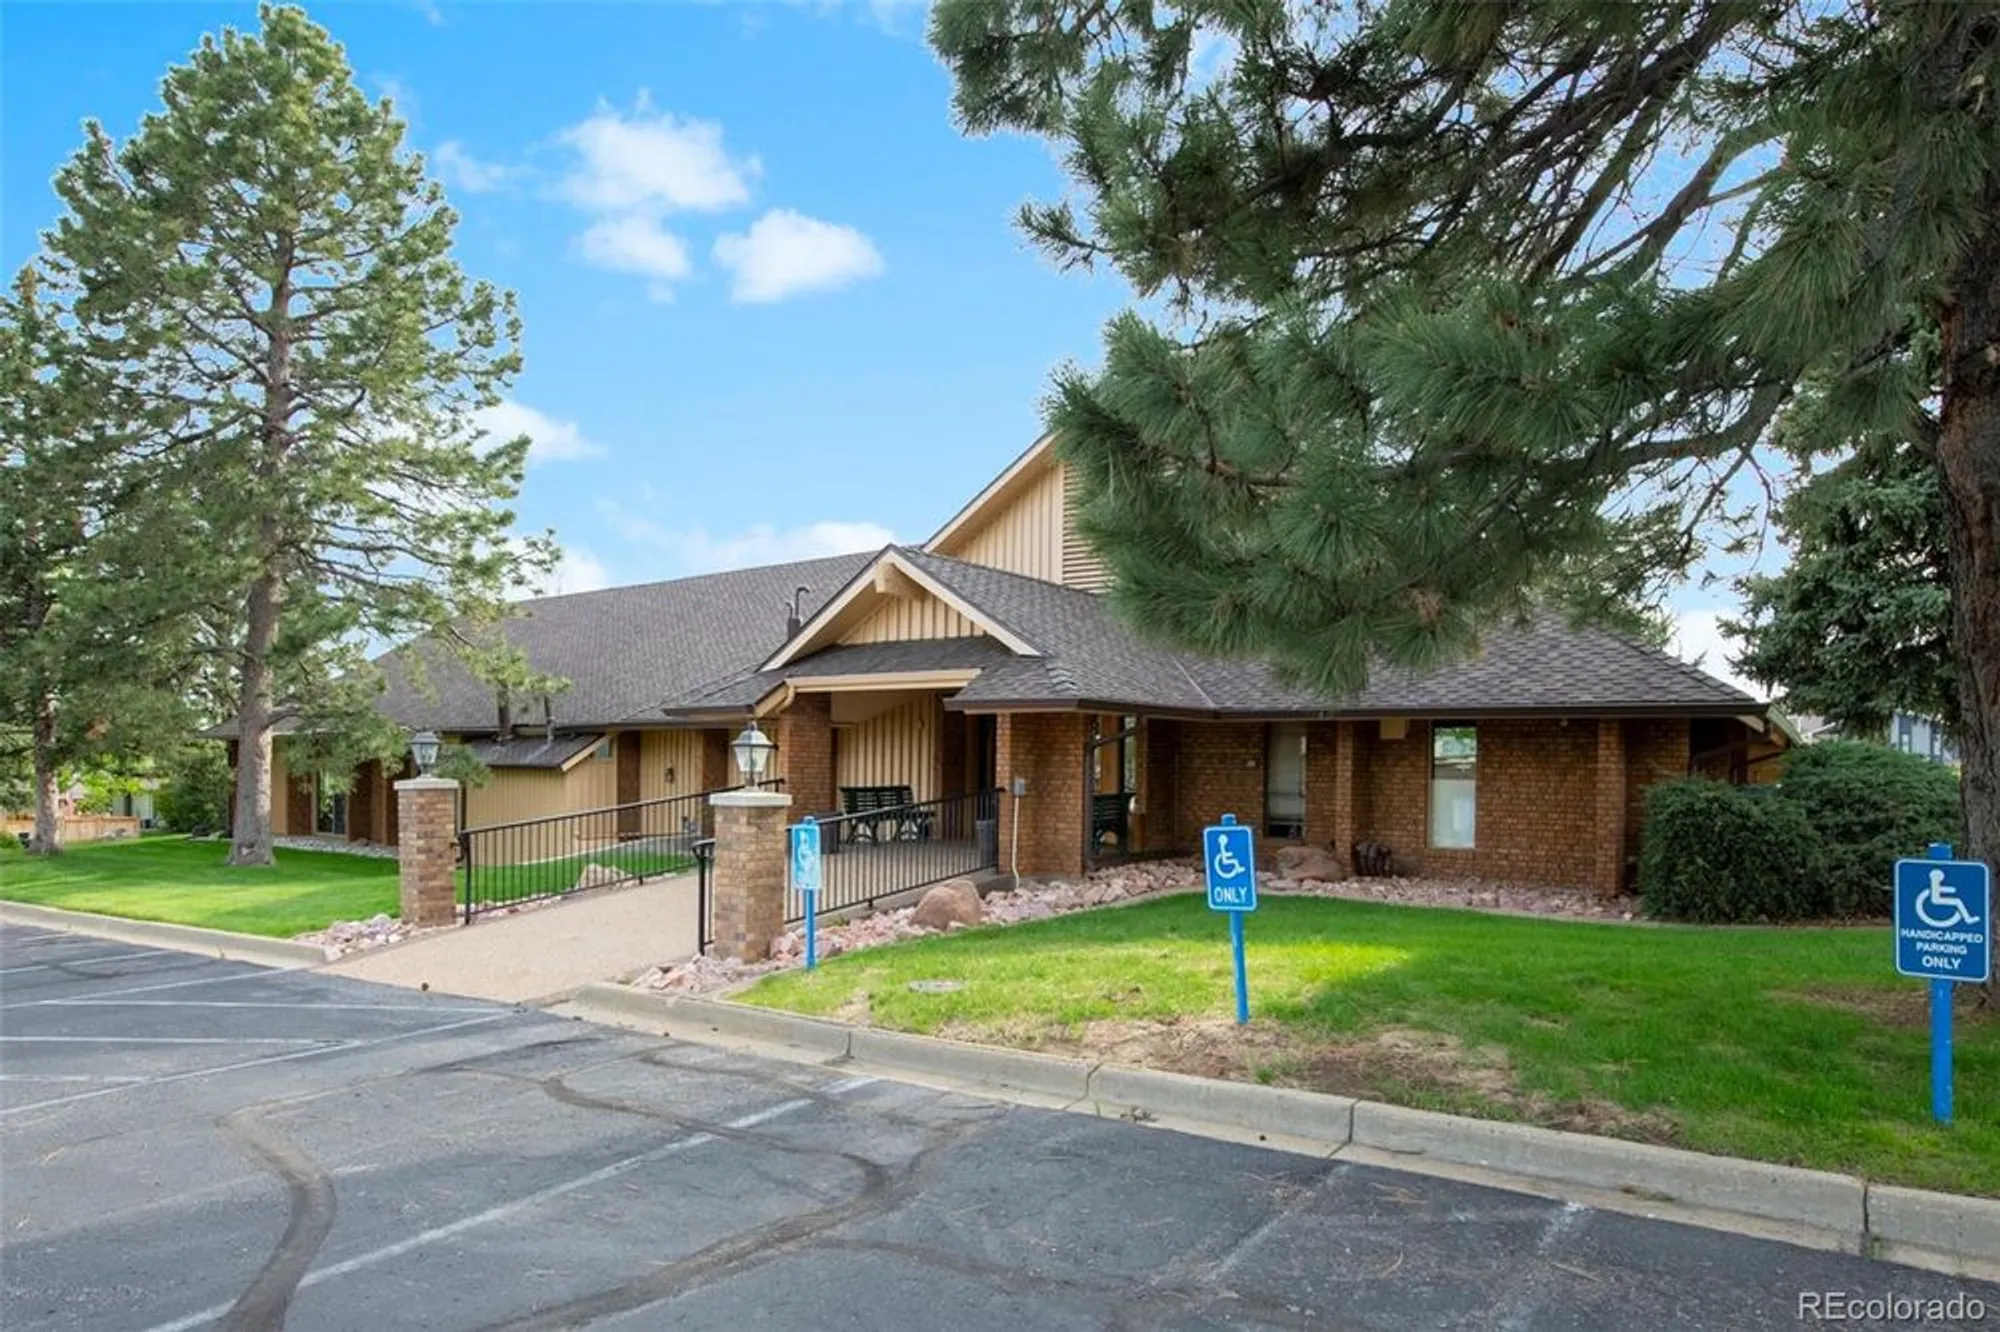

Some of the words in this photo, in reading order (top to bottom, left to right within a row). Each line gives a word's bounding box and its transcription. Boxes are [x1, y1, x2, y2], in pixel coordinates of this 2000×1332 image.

[1213, 886, 1248, 903] ONLY
[1900, 928, 1984, 943] HANDICAPPED
[1915, 941, 1968, 955] PARKING
[1922, 955, 1962, 970] ONLY
